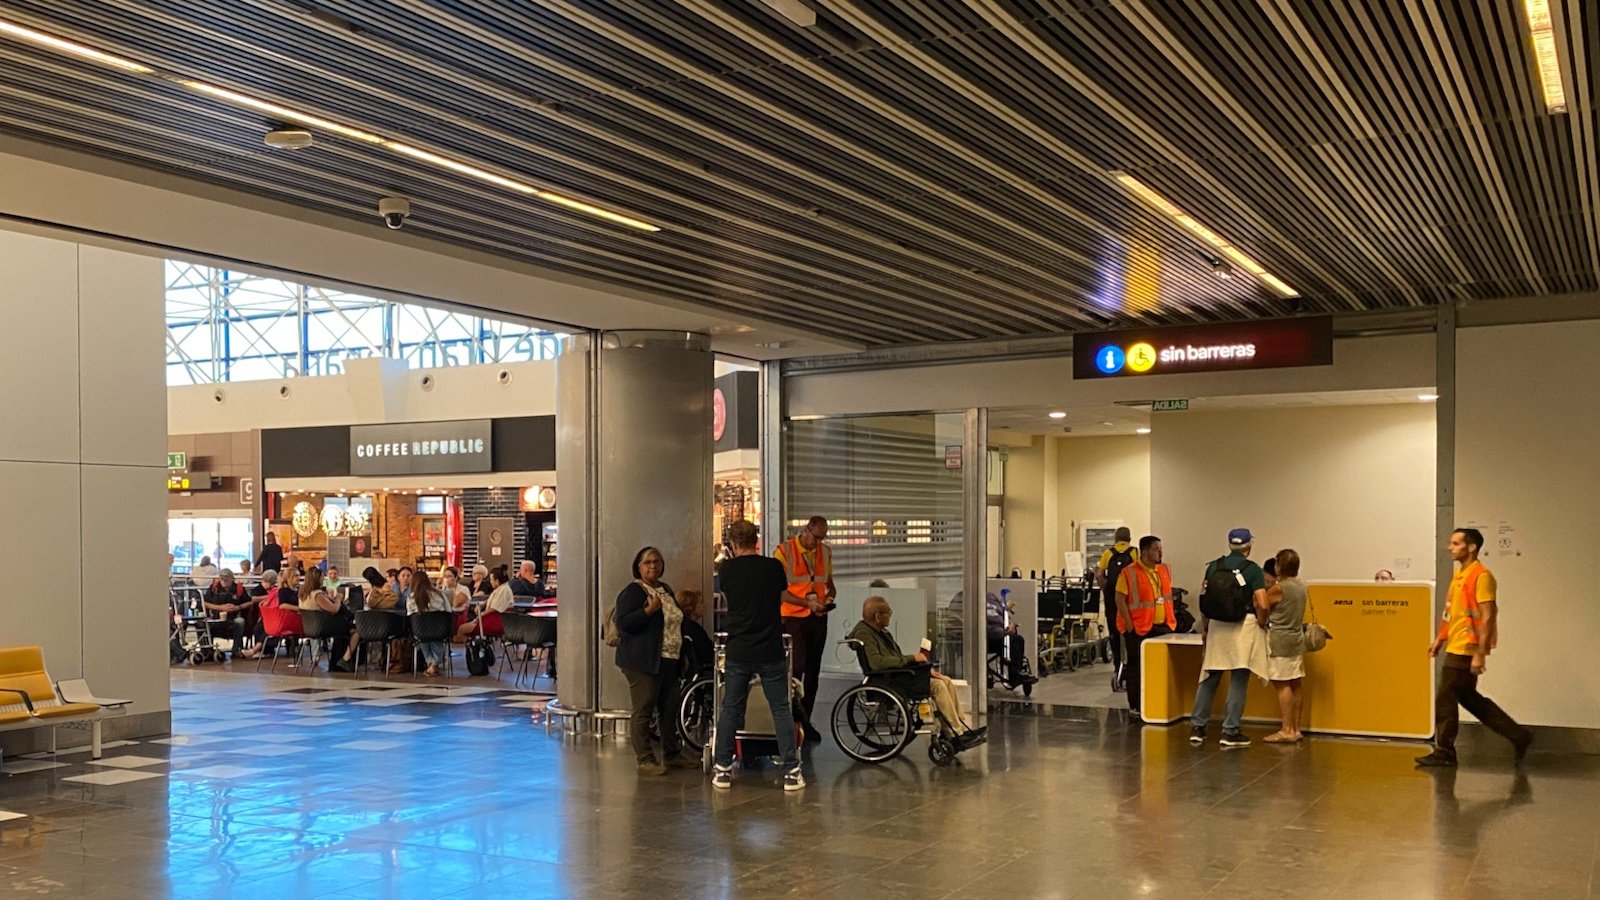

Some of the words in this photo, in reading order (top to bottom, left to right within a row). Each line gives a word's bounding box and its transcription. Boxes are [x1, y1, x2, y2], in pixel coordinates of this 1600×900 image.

[1160, 346, 1185, 362] sin
[1186, 344, 1256, 361] barreras
[356, 443, 408, 458] COFFEE
[412, 439, 484, 456] REPUBLIC
[1376, 599, 1409, 607] barreras
